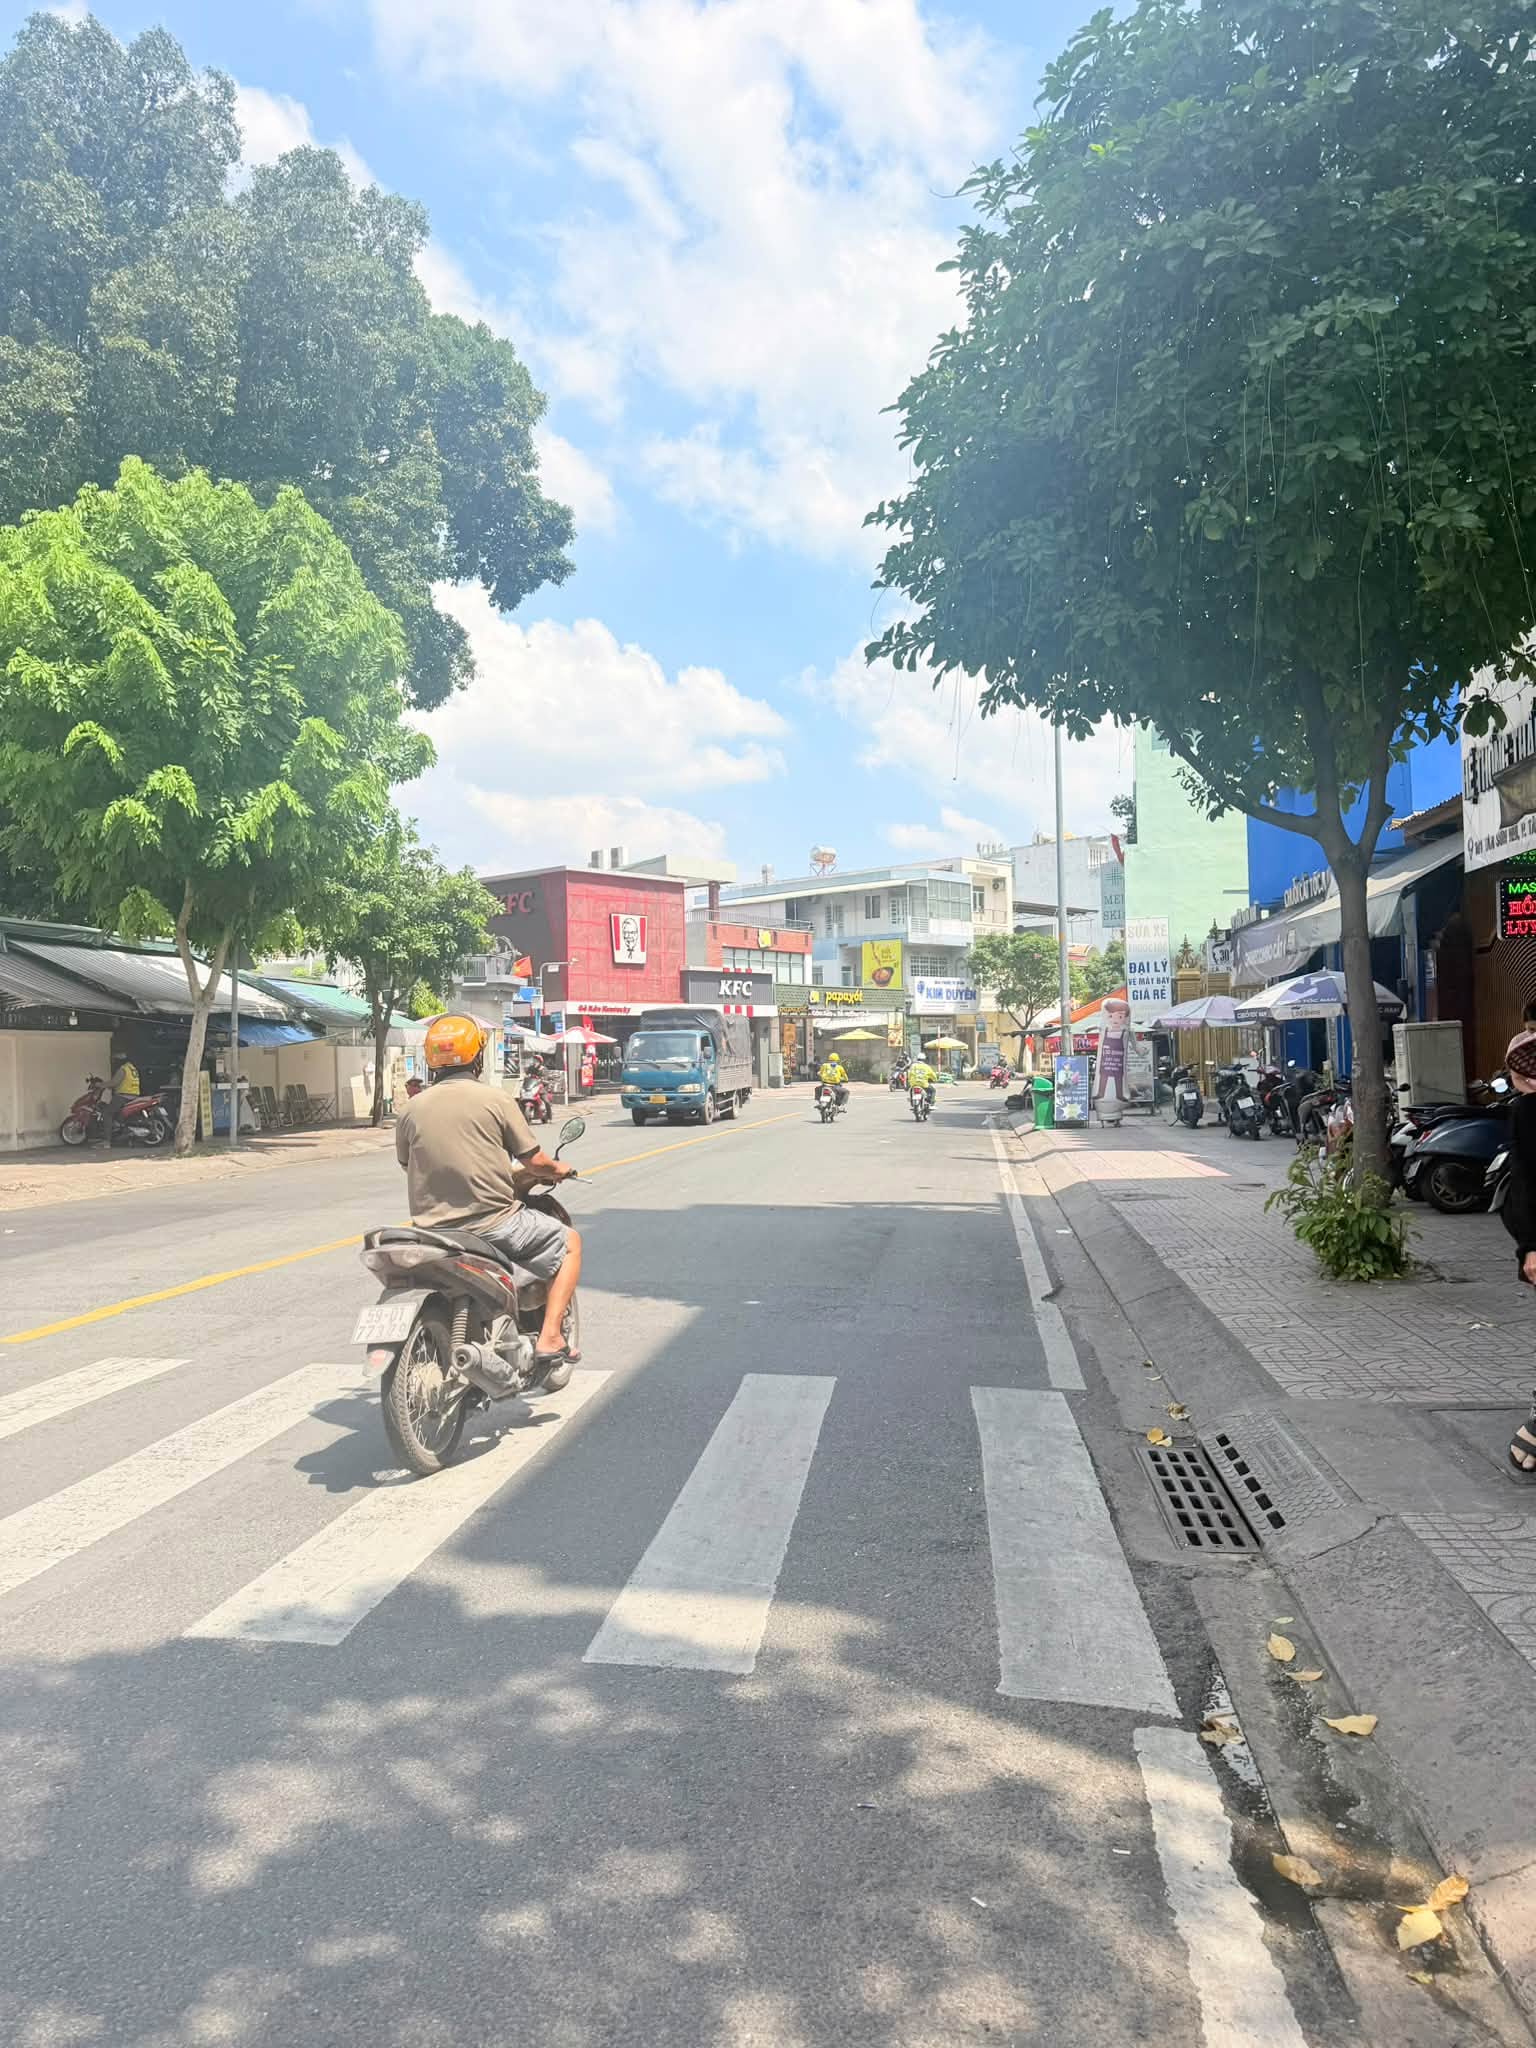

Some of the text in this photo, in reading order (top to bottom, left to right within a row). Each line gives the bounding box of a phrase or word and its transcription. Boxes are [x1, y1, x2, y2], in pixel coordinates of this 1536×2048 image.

[1129, 958, 1168, 975] ĐẠI LÝ
[719, 979, 753, 996] KFC
